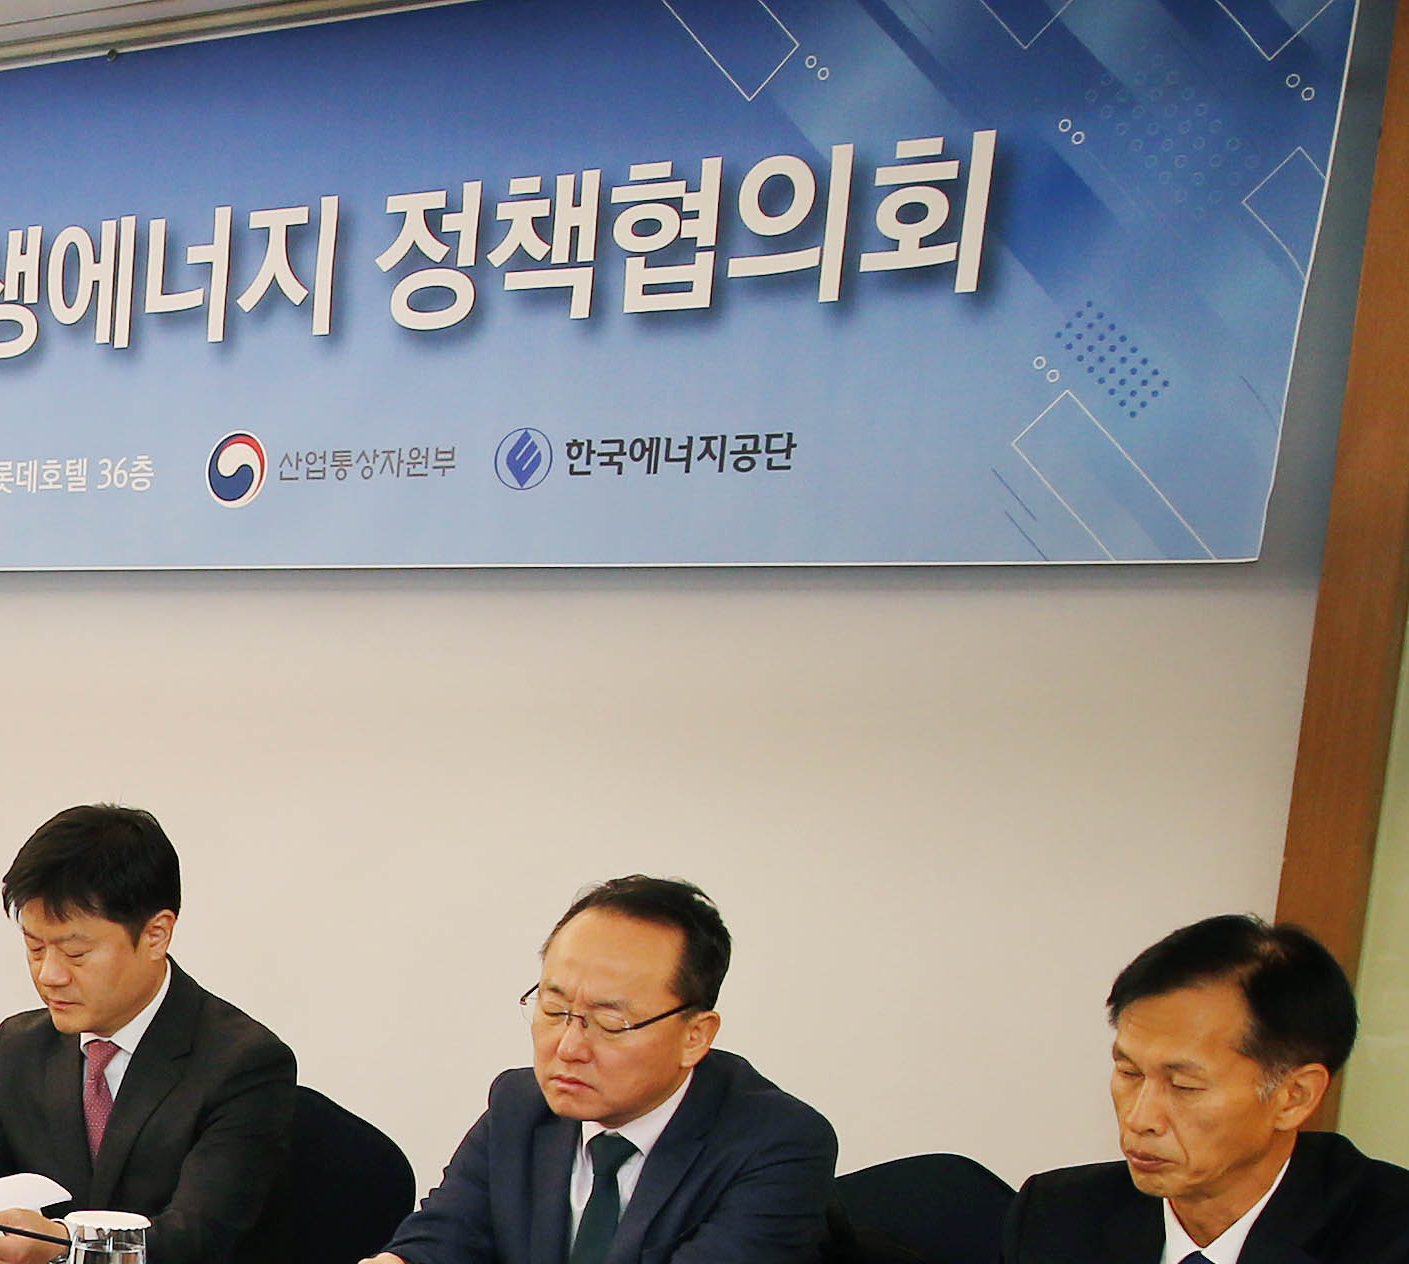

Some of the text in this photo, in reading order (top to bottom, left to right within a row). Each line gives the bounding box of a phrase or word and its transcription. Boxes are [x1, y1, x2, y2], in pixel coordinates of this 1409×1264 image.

[375, 129, 997, 331] 정책협의회
[96, 455, 155, 492] 36층
[277, 445, 458, 483] 산업통상자원부
[564, 431, 798, 477] 한국에너지공단
